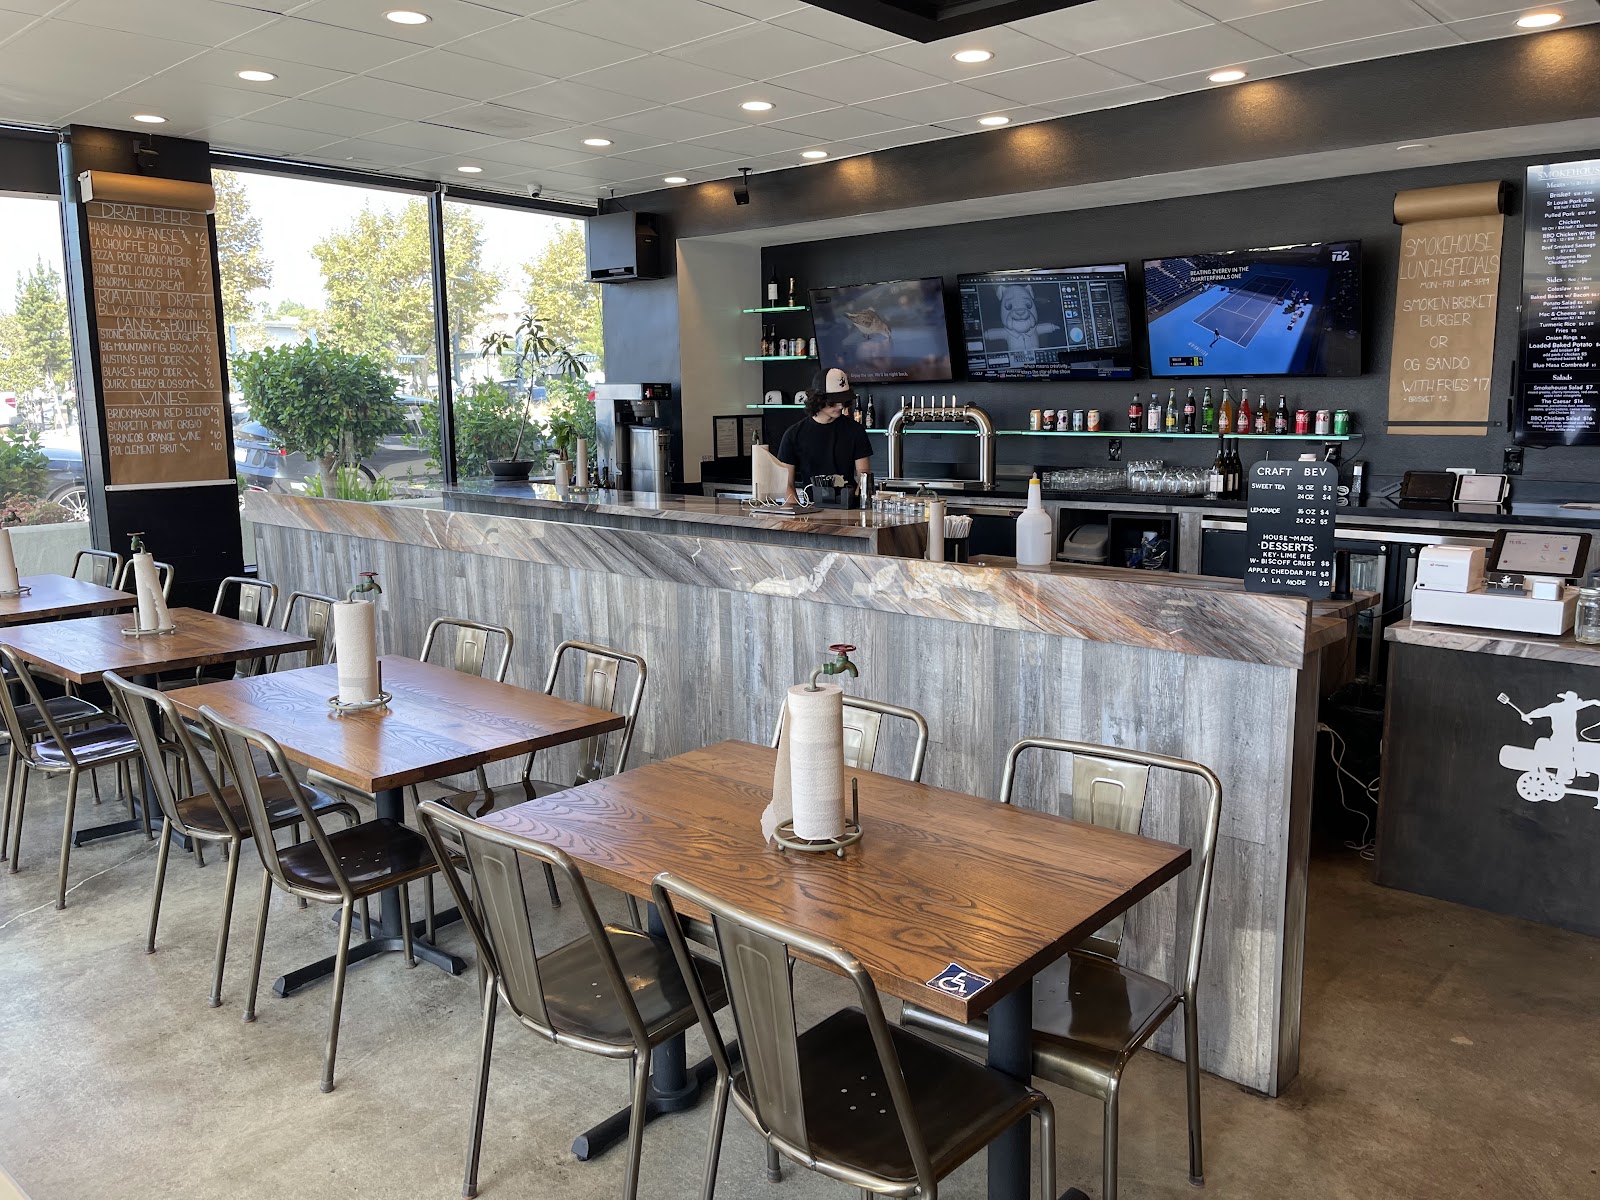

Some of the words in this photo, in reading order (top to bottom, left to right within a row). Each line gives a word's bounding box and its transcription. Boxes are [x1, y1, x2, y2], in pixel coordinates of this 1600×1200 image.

[102, 203, 149, 221] DRAFT
[153, 208, 192, 226] BEER
[90, 221, 132, 238] HARLAND
[133, 226, 179, 243] JAPANESE
[91, 237, 101, 249] LA
[103, 238, 147, 253] CHOUFFE
[148, 242, 183, 255] BLOND
[1404, 231, 1496, 258] SMOKEHOUSE
[92, 250, 114, 261] PIZZA
[117, 251, 137, 263] PORT
[166, 256, 194, 268] AMBER
[92, 262, 118, 274] STONE
[118, 264, 163, 278] DELICIOUS
[167, 268, 183, 280] IPA
[1399, 259, 1443, 280] LUNCH
[1443, 254, 1500, 277] SPECIALS
[94, 276, 134, 288] ABNORMAL
[134, 278, 156, 289] HAZY
[156, 279, 185, 291] DREAM
[1190, 274, 1230, 283] QUARTERFINALS
[168, 293, 210, 308] DRAFT
[1451, 293, 1496, 310] BRISKET
[97, 303, 130, 316] BLVD
[166, 307, 198, 319] SAISON
[116, 317, 152, 331] CANS
[1419, 312, 1473, 328] BURGER
[100, 329, 124, 340] STONE
[126, 330, 171, 341] BUENAVESA
[171, 331, 200, 342] LAGER
[1429, 335, 1449, 349] OR
[100, 341, 114, 352] BIG
[114, 342, 152, 352] MOUNTAIN
[153, 342, 167, 353] FIG
[170, 343, 203, 353] BROWN
[102, 354, 138, 364] AUSTIN'S
[139, 354, 158, 365] EAST
[160, 355, 183, 366] CIDER
[1403, 358, 1420, 371] OG
[1425, 356, 1470, 371] SANDO
[102, 366, 136, 377] BLAKE'S
[138, 366, 160, 378] HARD
[162, 367, 184, 377] CIDER
[103, 378, 129, 390] QUIRK
[158, 378, 195, 390] BLOSSOM
[1402, 379, 1435, 393] WITH
[1436, 379, 1470, 392] FRIES
[139, 391, 189, 405] WINES
[1408, 395, 1436, 403] BRISKET
[107, 408, 160, 419] BRICKMASON
[163, 407, 183, 418] RED
[185, 407, 211, 418] BLEND
[107, 420, 149, 431] SCARPETTA
[151, 420, 174, 430] PINOT
[177, 419, 202, 430] GRIGIO
[108, 432, 144, 443] PIRINEOS
[146, 431, 176, 443] ORANGE
[178, 430, 201, 442] WINE
[109, 445, 124, 457] POL
[124, 444, 156, 455] CLEMENT
[159, 443, 178, 454] BRUT
[1257, 467, 1292, 476] CRAFT
[1304, 468, 1327, 476] BEV
